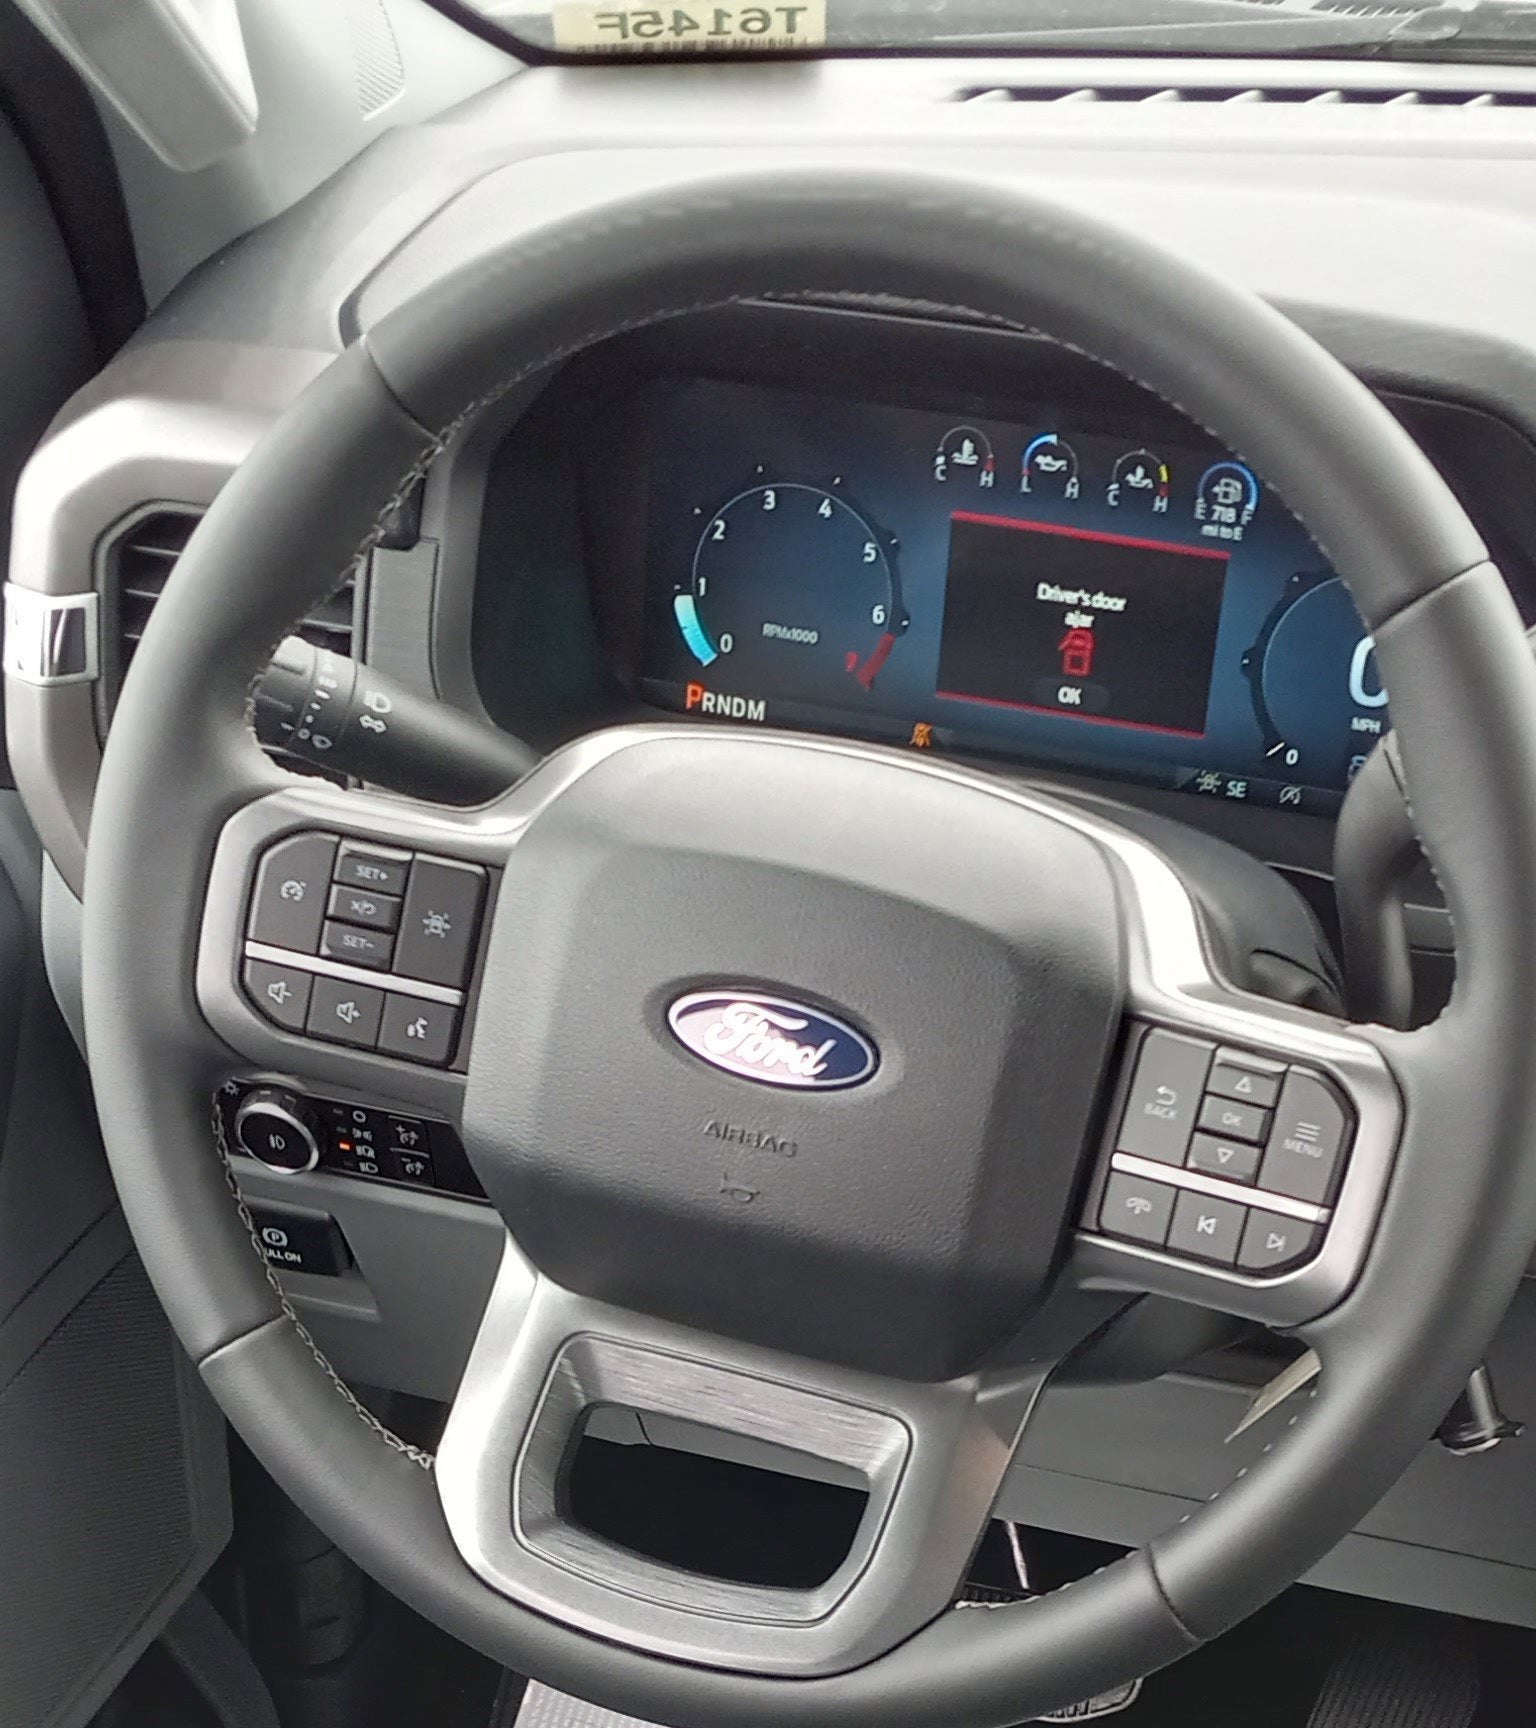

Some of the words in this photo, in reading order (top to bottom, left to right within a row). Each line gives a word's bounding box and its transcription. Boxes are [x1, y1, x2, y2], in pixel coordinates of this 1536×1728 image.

[762, 490, 776, 511] 3
[818, 498, 832, 519] 4
[711, 520, 726, 541] 2
[863, 542, 877, 563] 5
[698, 576, 707, 597] 1
[1090, 590, 1127, 612] door
[872, 604, 885, 625] 6
[719, 633, 733, 654] 0
[1057, 685, 1082, 706] OK
[1350, 716, 1382, 734] MPH
[1284, 748, 1299, 766] 0
[702, 1000, 838, 1078] Ford
[702, 1118, 800, 1159] AIRBAG
